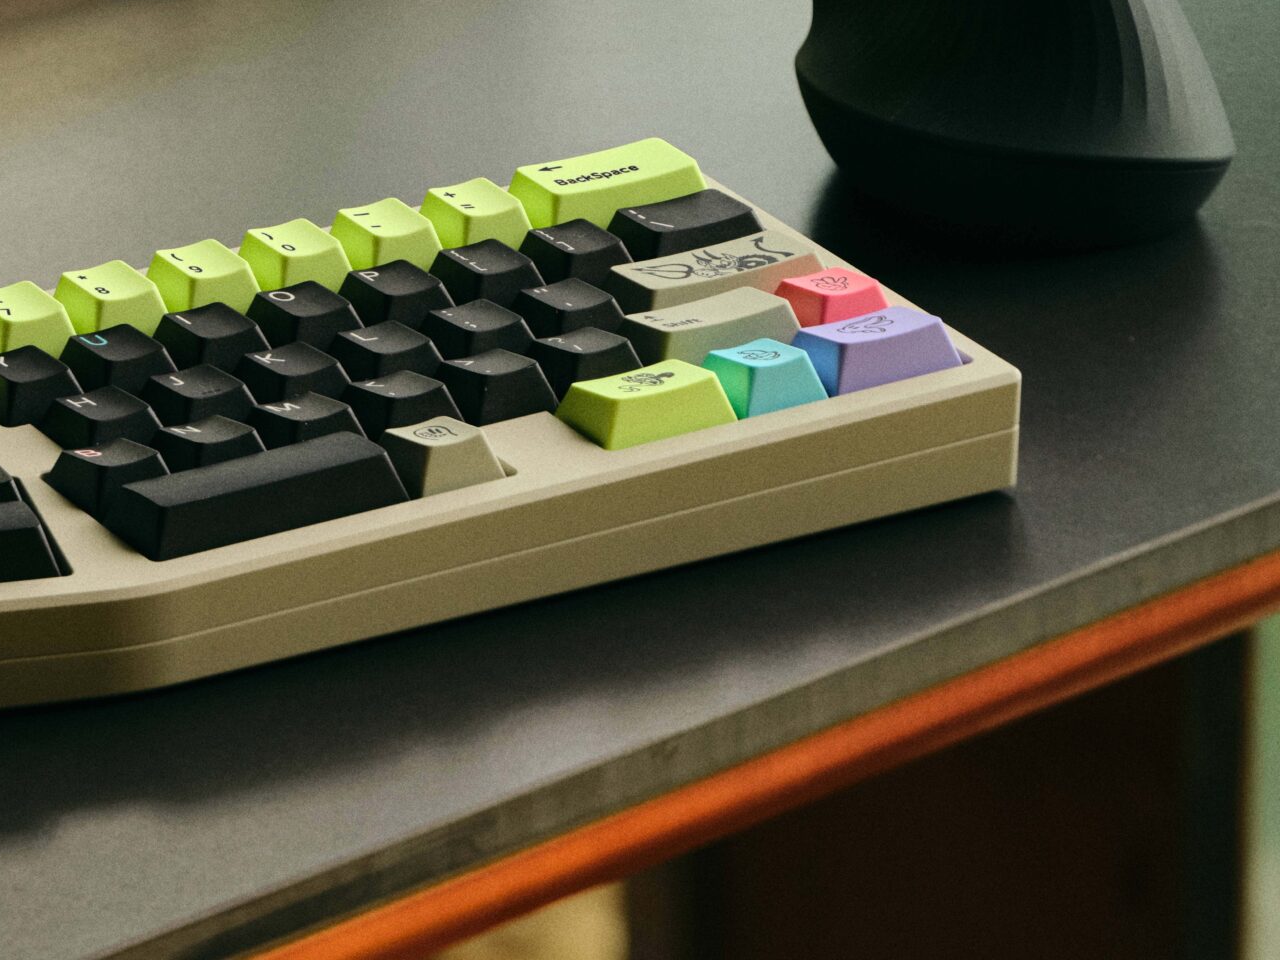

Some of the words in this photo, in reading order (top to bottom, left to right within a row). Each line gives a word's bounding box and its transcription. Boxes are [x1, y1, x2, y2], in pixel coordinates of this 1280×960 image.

[554, 165, 639, 186] BackSpace
[359, 272, 378, 281] P
[94, 286, 110, 295] 8
[269, 291, 295, 301] O
[80, 335, 108, 345] U
[349, 332, 378, 341] L
[255, 353, 285, 364] K
[170, 376, 184, 386] J
[66, 397, 97, 408] H
[265, 403, 300, 412] M
[170, 426, 202, 434] N
[75, 449, 102, 457] B
